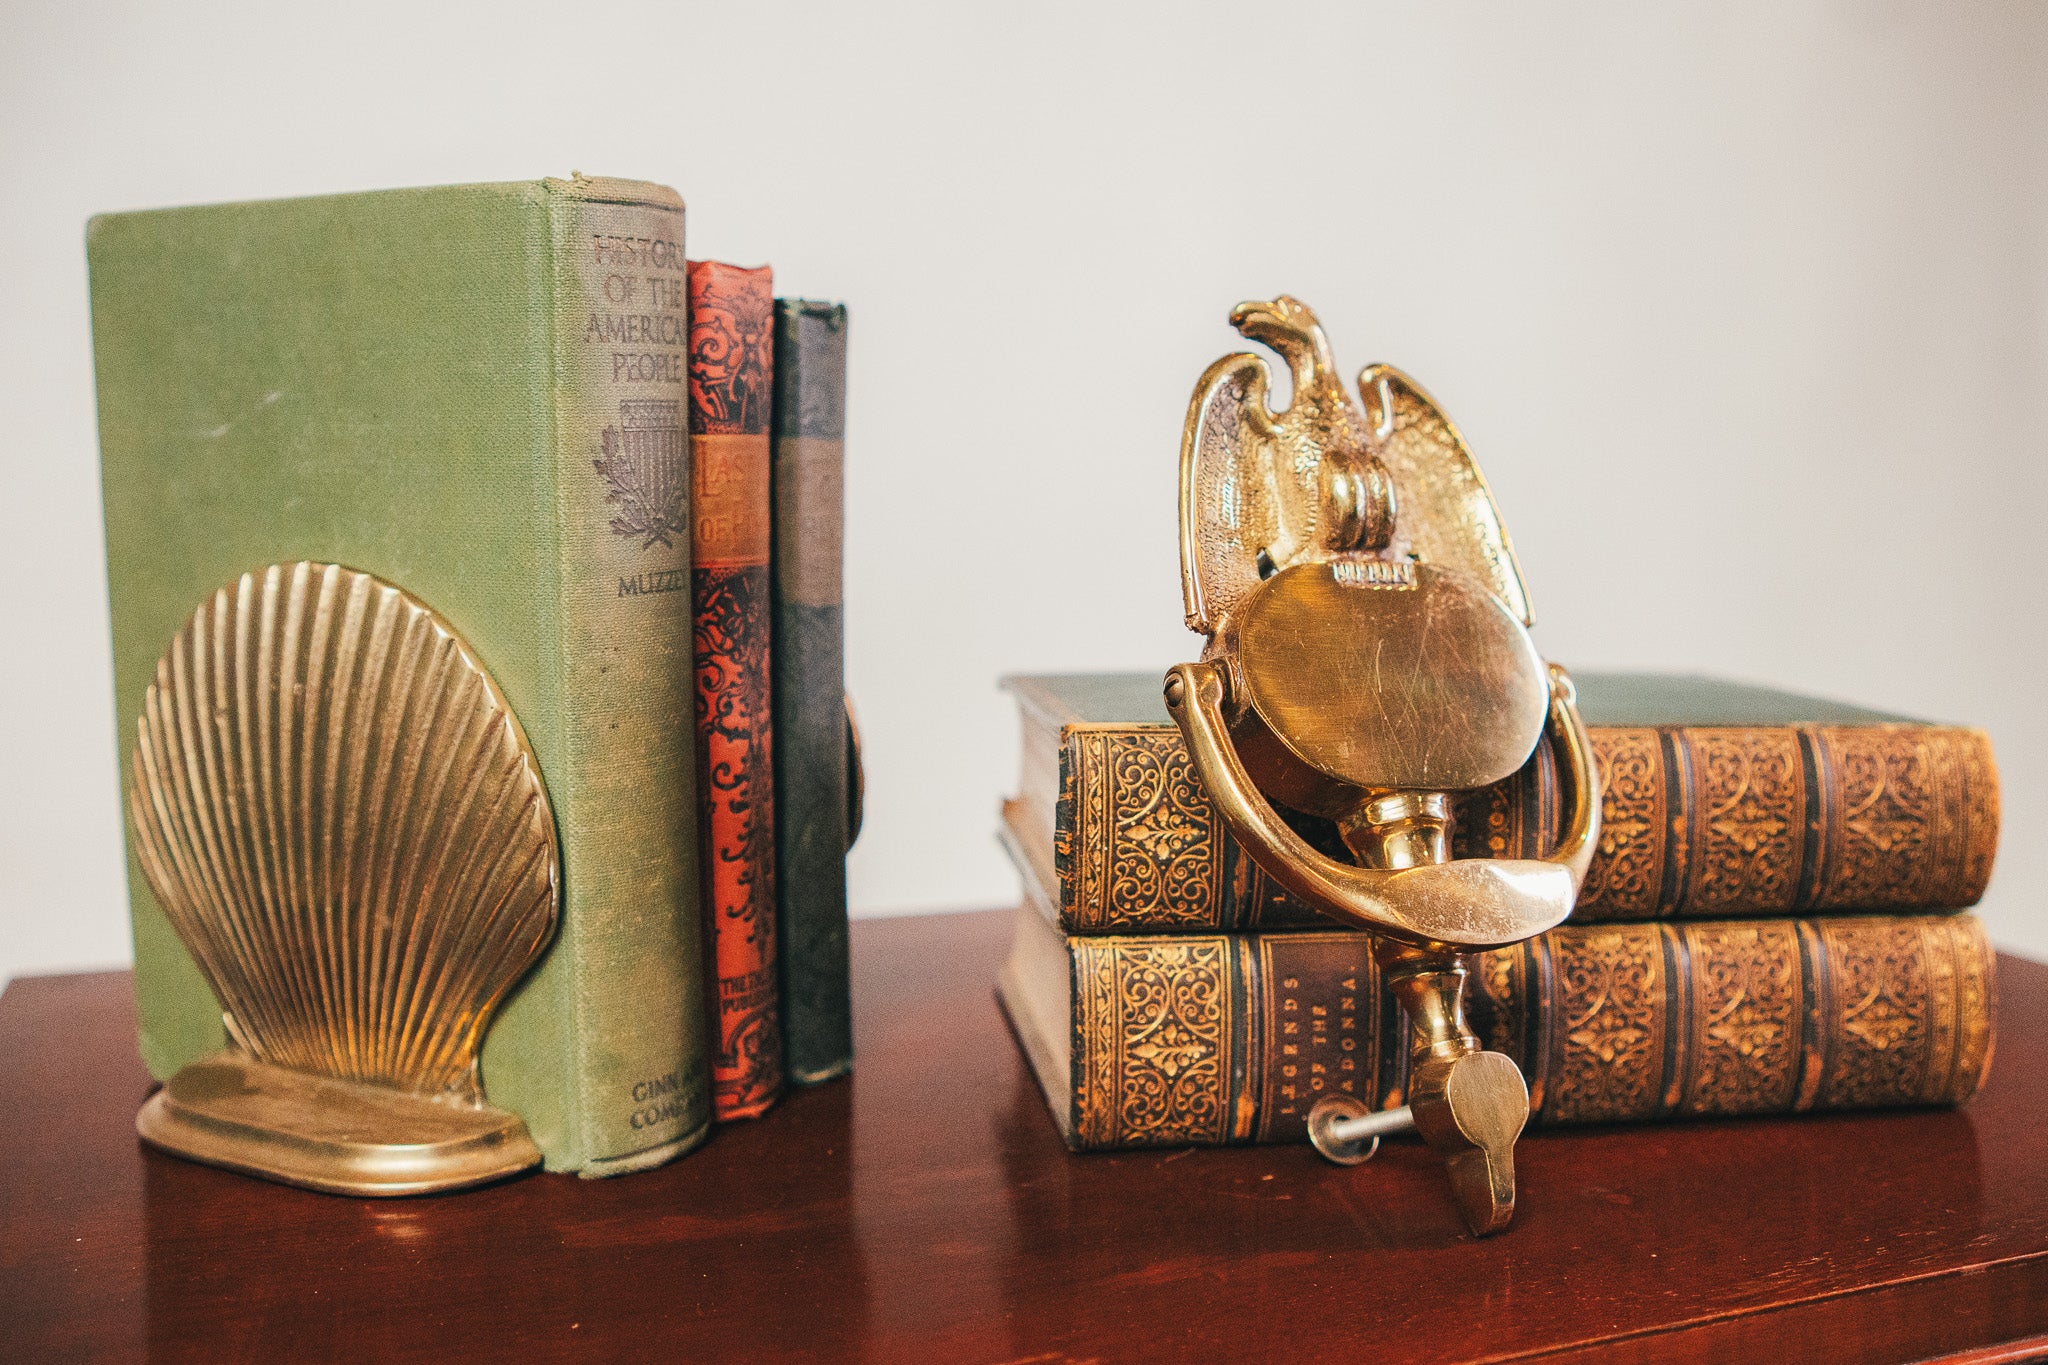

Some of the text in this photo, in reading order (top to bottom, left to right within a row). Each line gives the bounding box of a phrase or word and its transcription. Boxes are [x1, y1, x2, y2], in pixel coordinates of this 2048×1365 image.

[593, 233, 685, 272] HISTOR
[603, 273, 682, 309] OF THE
[583, 312, 687, 346] AMERICA
[612, 352, 682, 384] PEOPLE
[617, 568, 687, 598] MUZZE
[1280, 977, 1299, 1115] LEGENDS
[1340, 965, 1357, 1092] ADONNA.
[1310, 1004, 1328, 1091] OF THE
